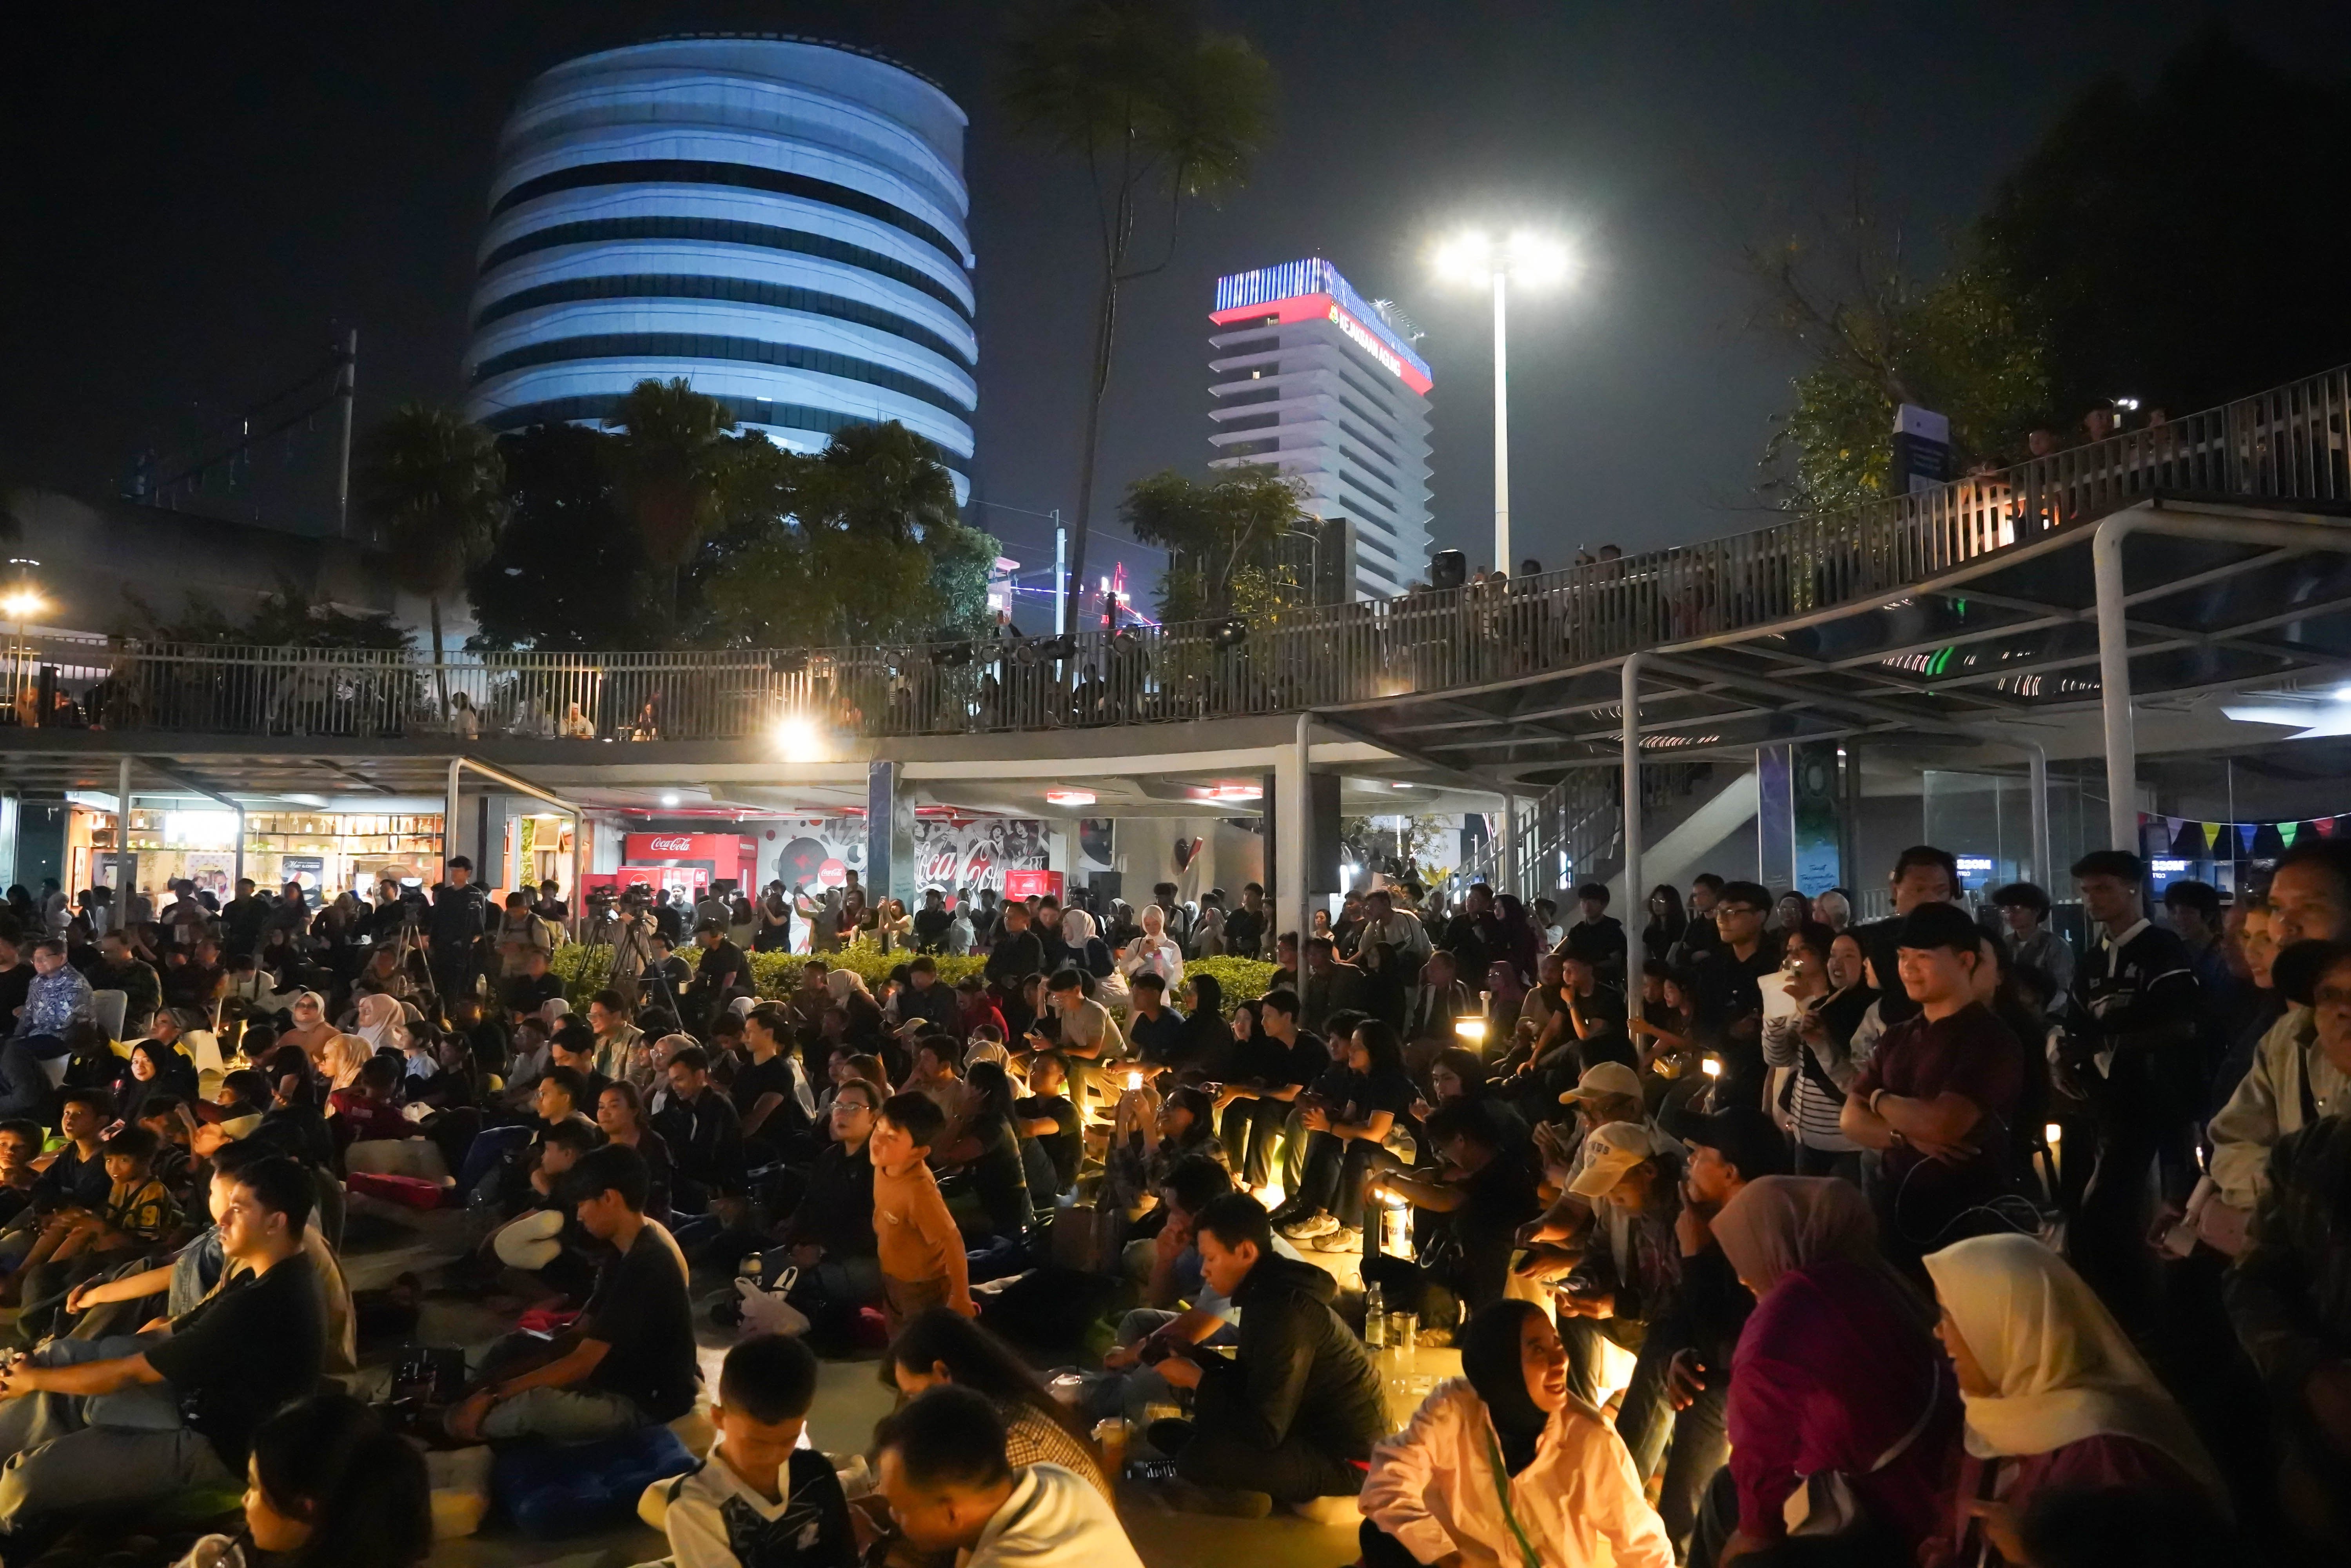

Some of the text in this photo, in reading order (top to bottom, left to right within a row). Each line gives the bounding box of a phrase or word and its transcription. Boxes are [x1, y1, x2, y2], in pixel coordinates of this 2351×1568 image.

[1340, 312, 1400, 377] KEJAKSAAN AGUNG
[651, 837, 692, 851] Coca-Cola
